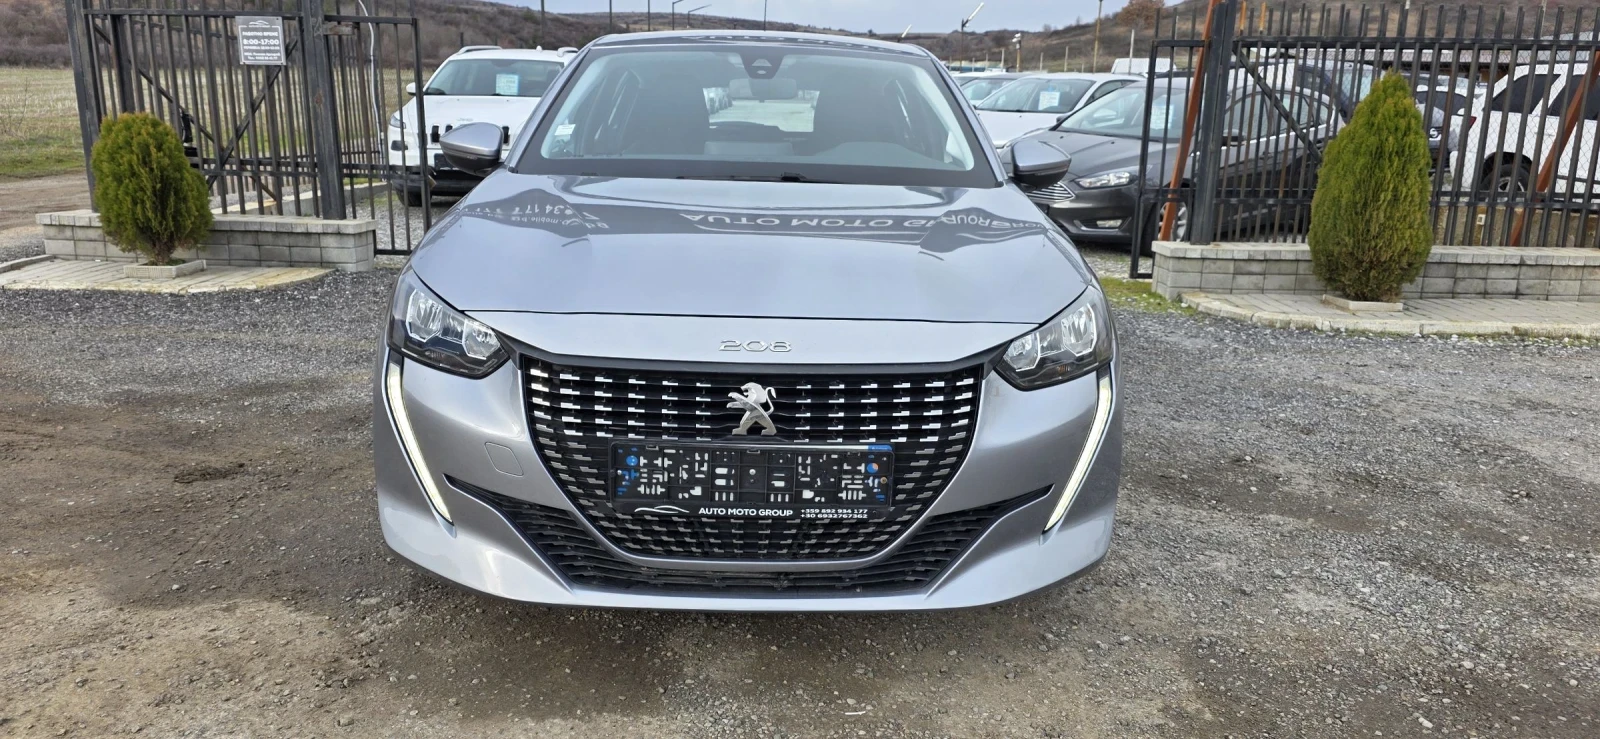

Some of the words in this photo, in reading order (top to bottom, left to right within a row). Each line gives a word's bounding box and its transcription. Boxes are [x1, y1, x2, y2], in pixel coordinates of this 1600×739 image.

[719, 340, 792, 352] 208
[699, 507, 726, 516] AUTO
[727, 508, 757, 517] MOTO
[758, 508, 794, 518] GROUP
